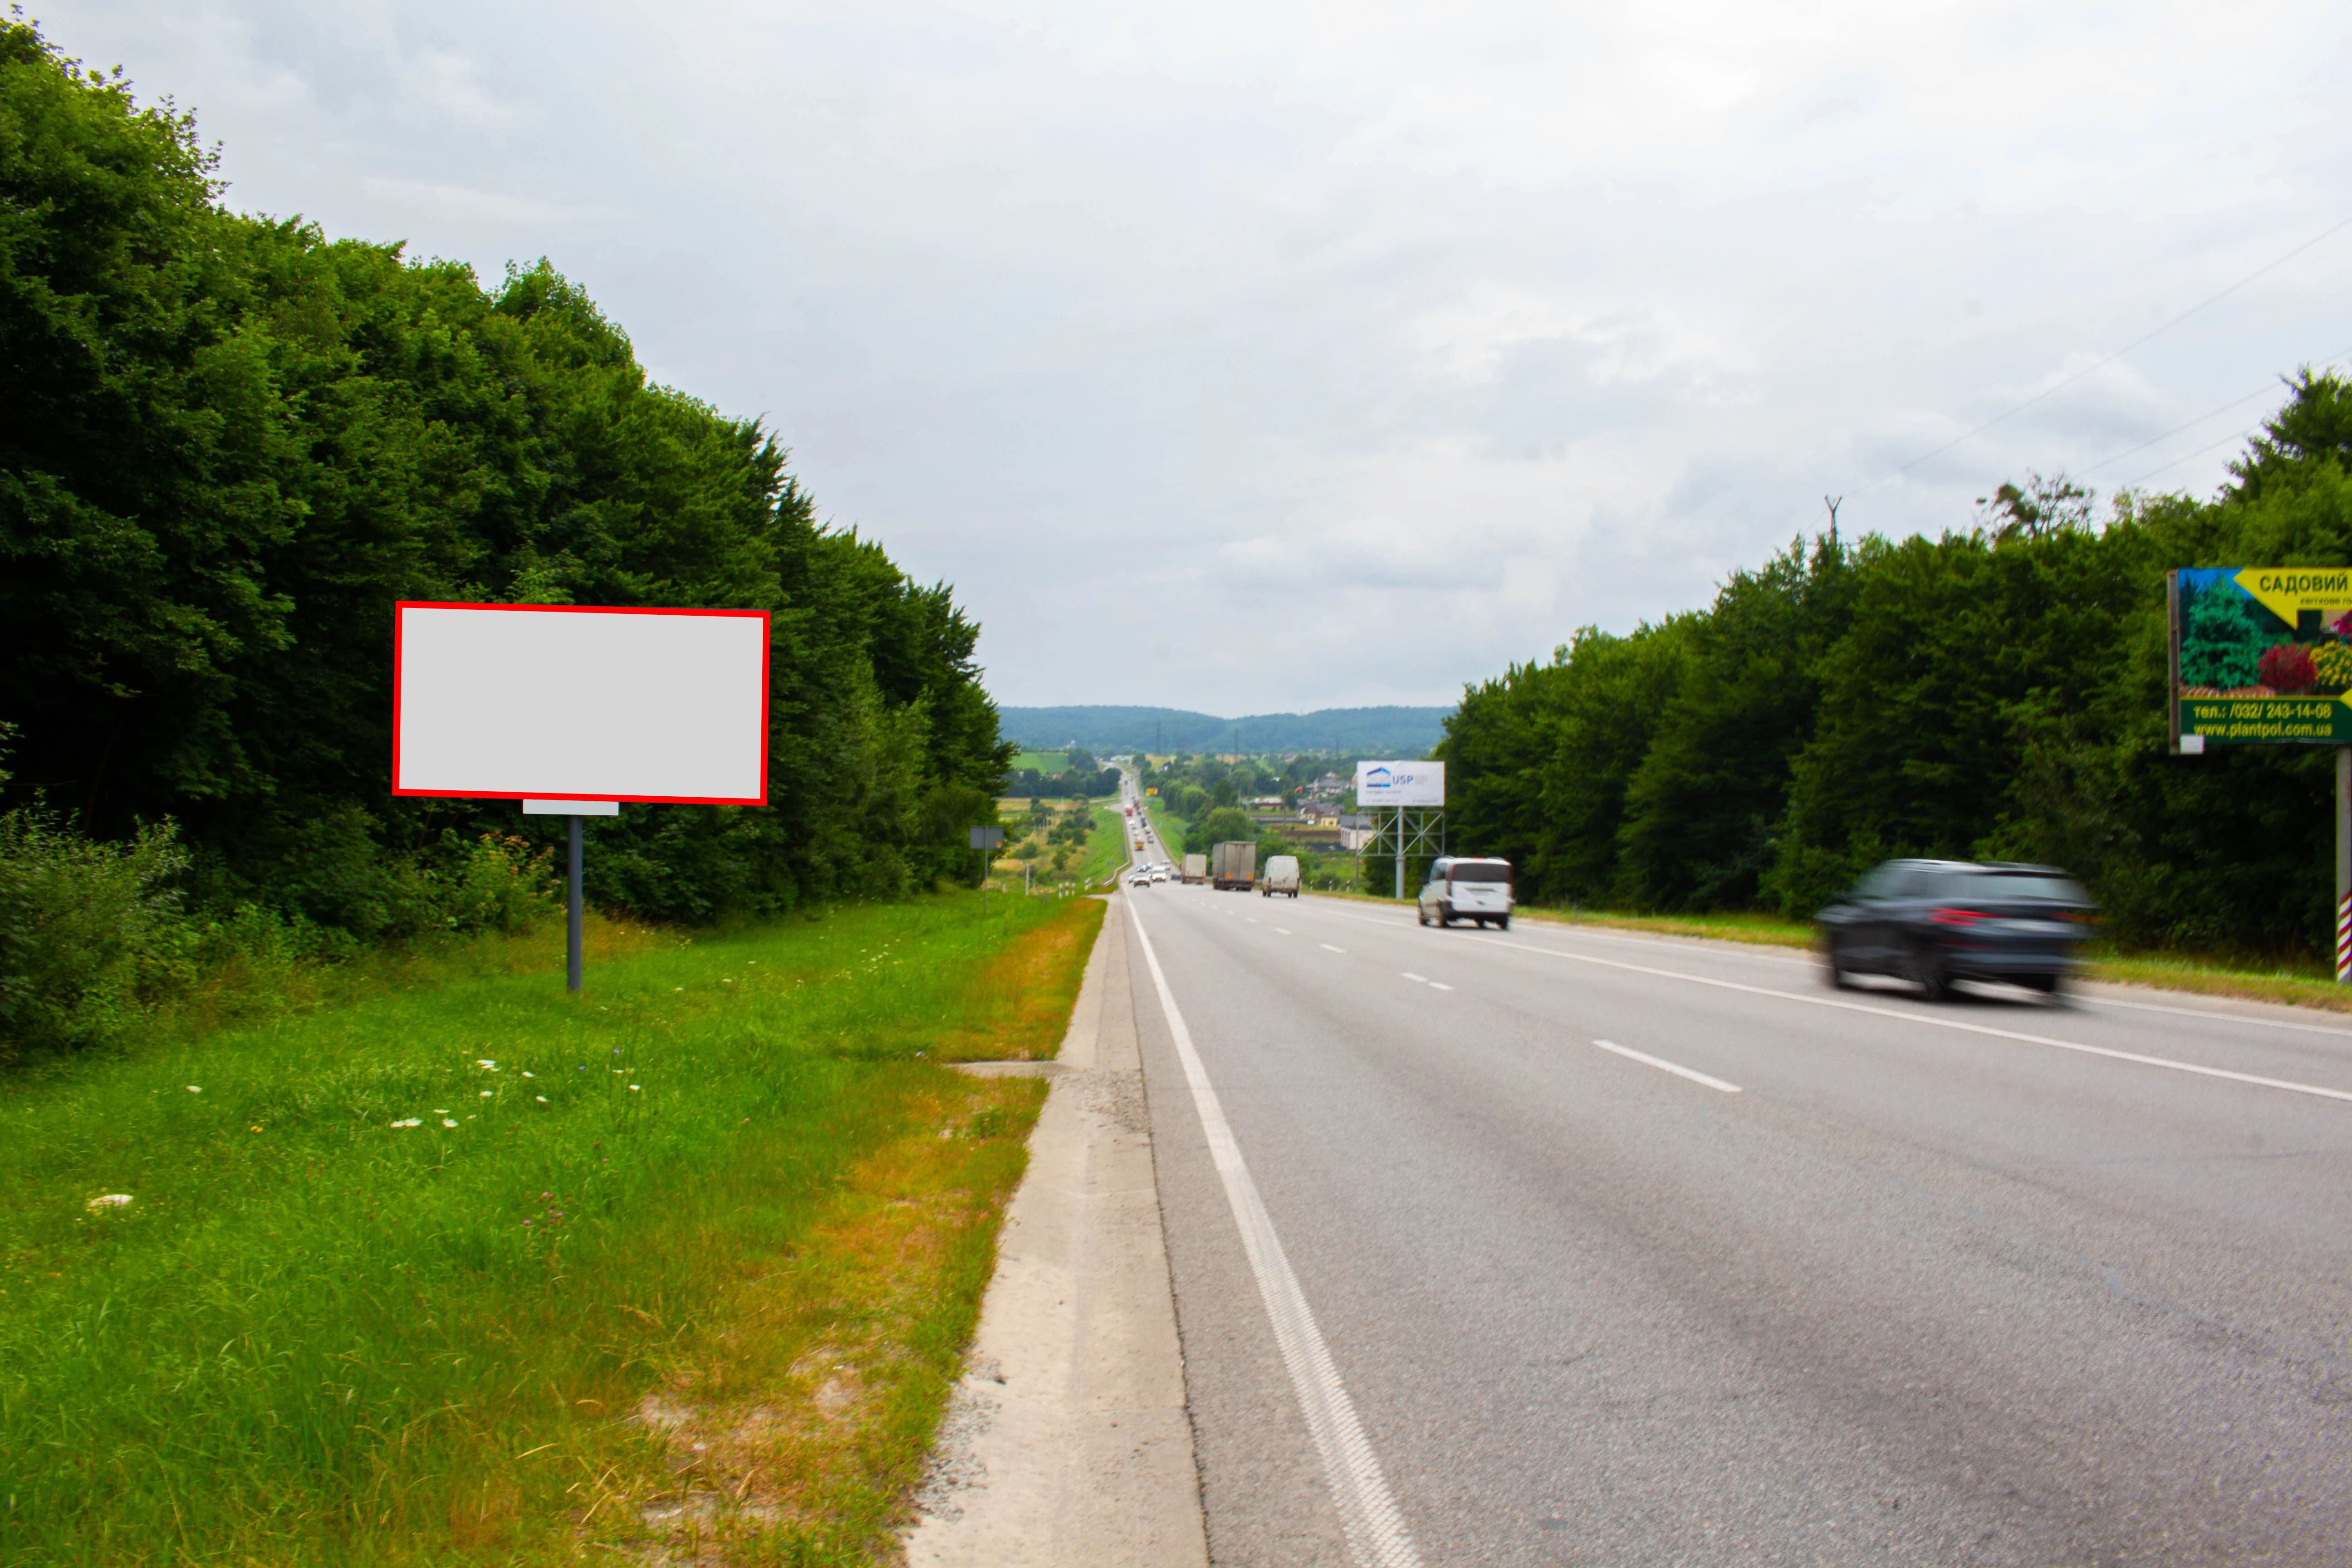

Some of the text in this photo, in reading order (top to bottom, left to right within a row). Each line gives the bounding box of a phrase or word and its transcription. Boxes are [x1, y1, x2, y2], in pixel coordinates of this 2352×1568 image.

[2259, 570, 2348, 596] САДОВИЙ
[2230, 703, 2264, 719] /032/
[2267, 703, 2332, 719] 243-14-08
[2193, 720, 2332, 740] www.plantpol.com.ua
[1392, 775, 1414, 785] USP
